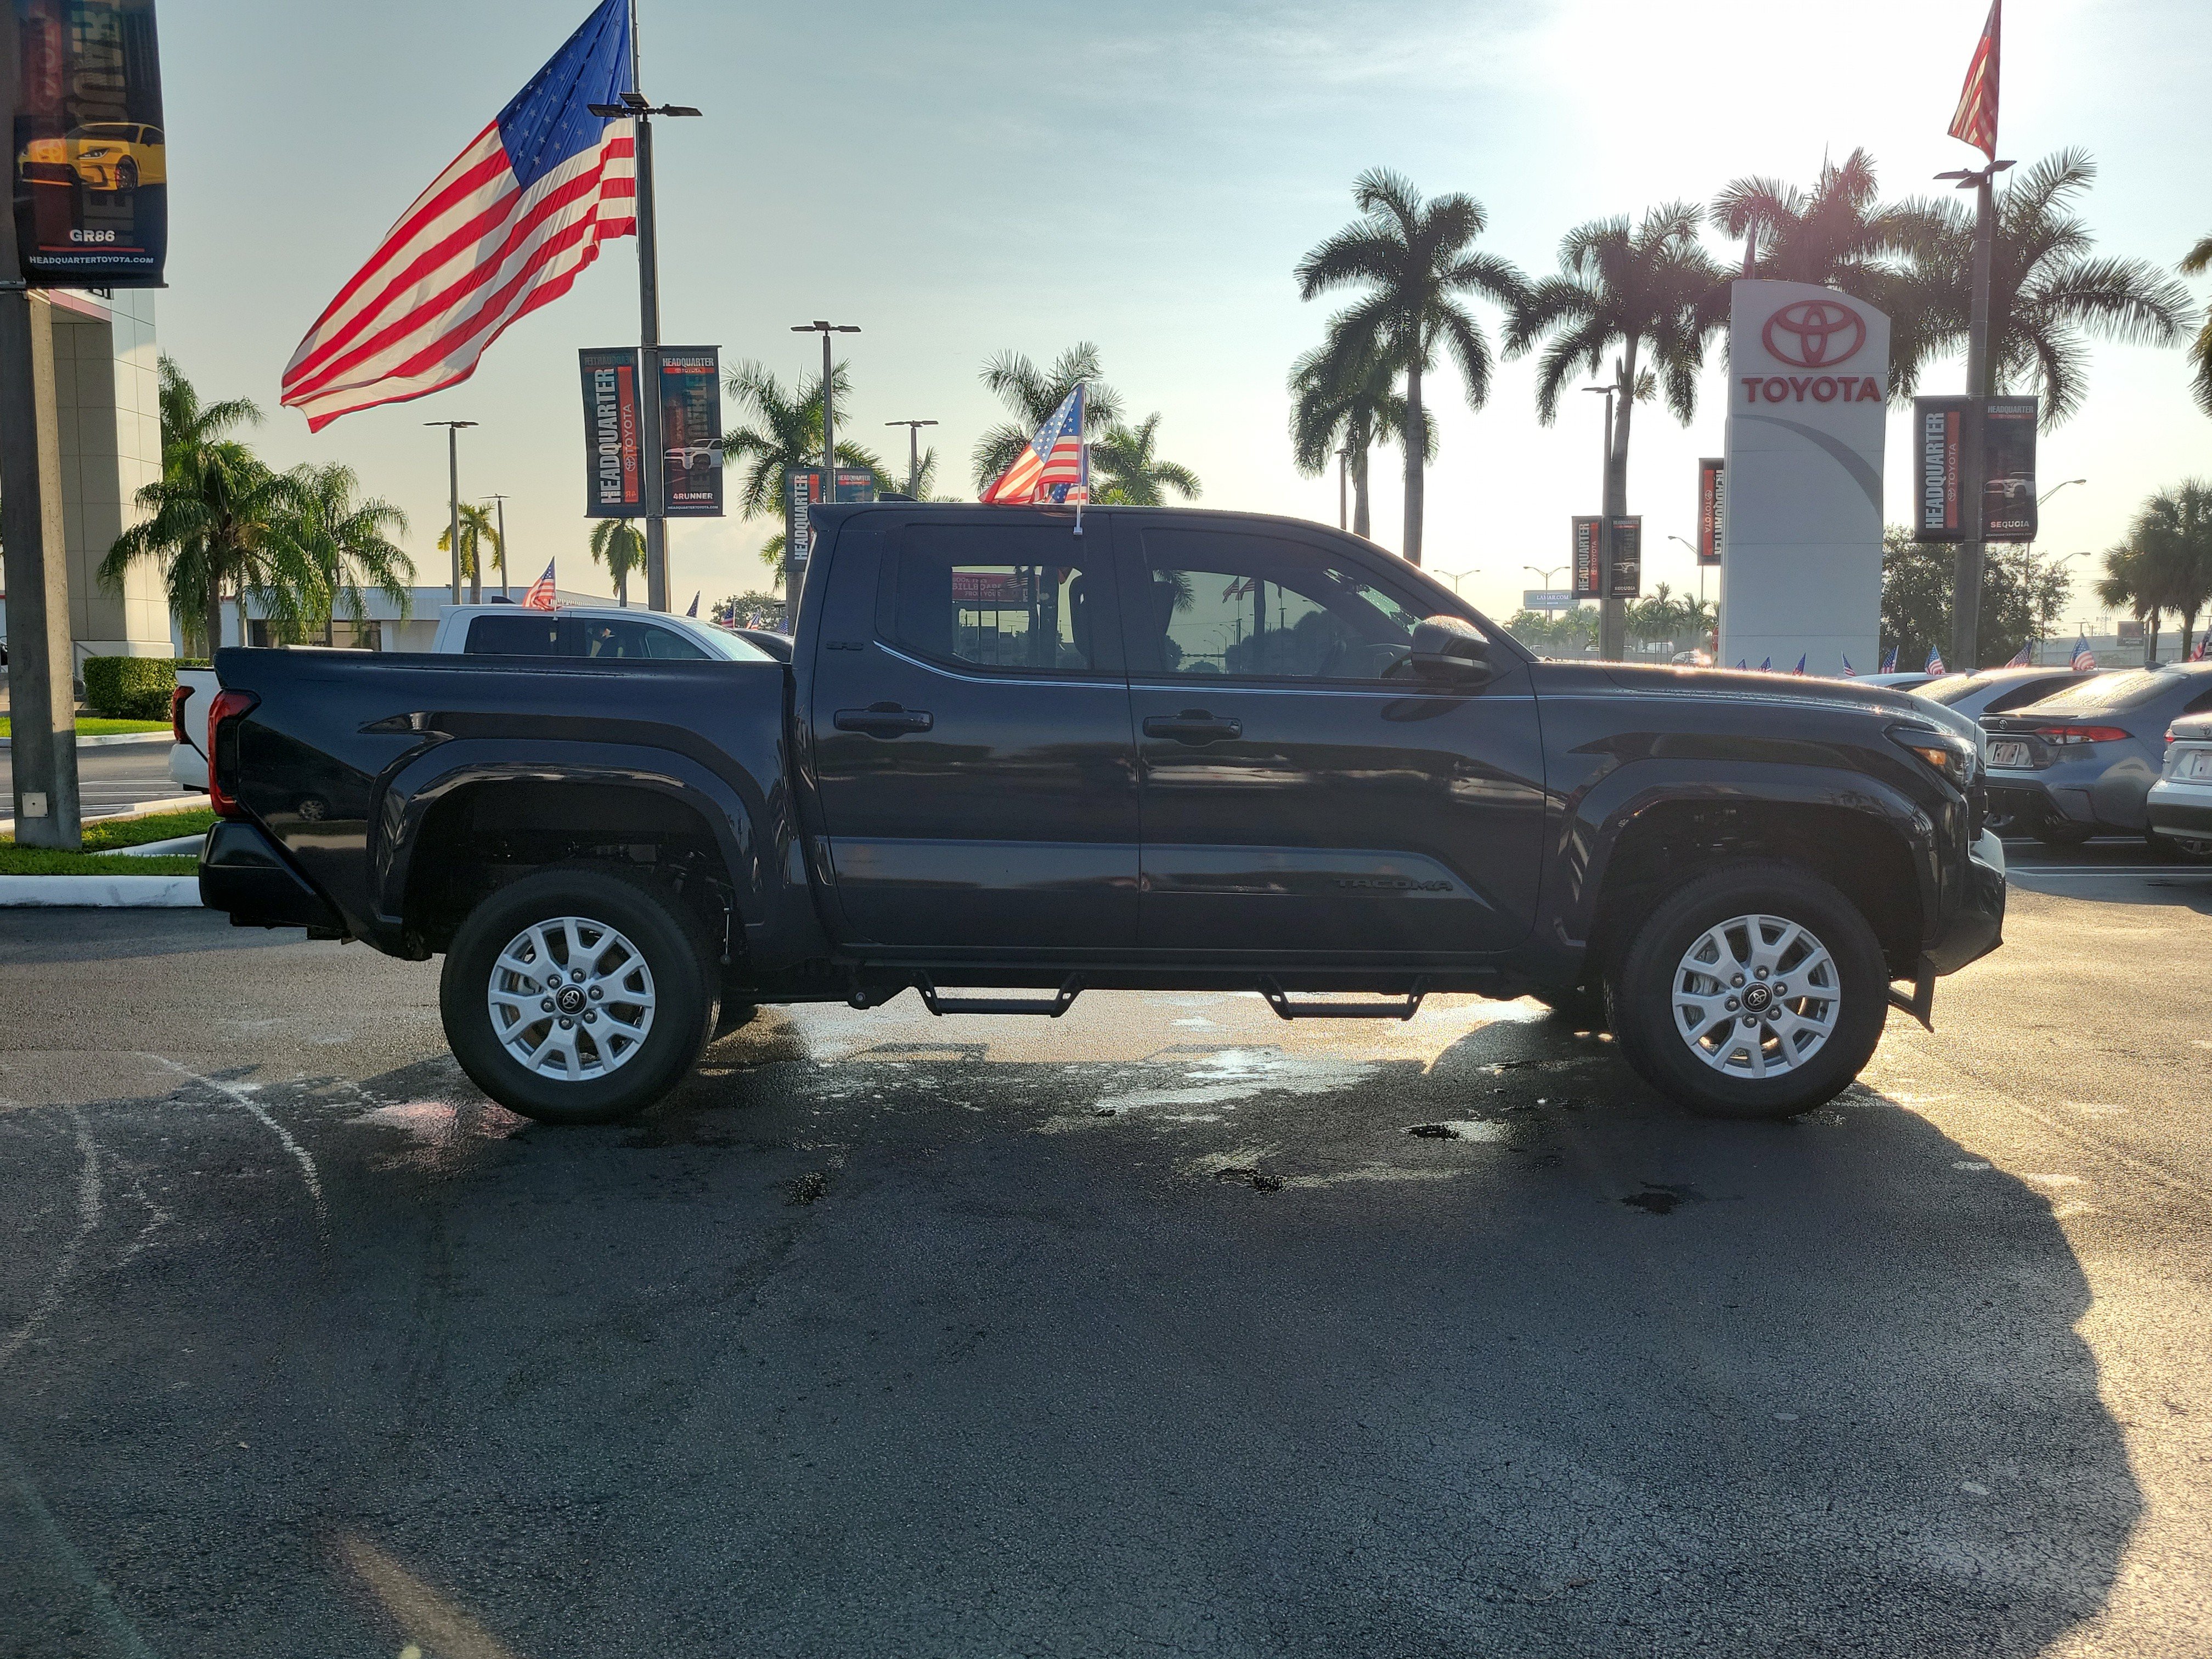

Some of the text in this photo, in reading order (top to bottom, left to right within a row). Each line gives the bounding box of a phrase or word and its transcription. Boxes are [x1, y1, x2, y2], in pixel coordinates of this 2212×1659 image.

[70, 229, 115, 242] GR86
[30, 256, 154, 264] HEADQUARTERTOYOTA.COM
[663, 358, 714, 368] HEADQUARTER
[1741, 376, 1882, 402] TOYOTA
[1988, 405, 2034, 414] HEADQUARTER
[595, 368, 622, 504] HEADQUARTER
[623, 404, 634, 454] TOYOTA
[1926, 413, 1946, 528] HEADQUARTER
[1948, 443, 1956, 487] TOYOTA
[794, 475, 810, 560] HEADQUARTER
[1990, 520, 2029, 528] SEQUOIA
[1578, 523, 1590, 591] HEADQUARTER
[1334, 879, 1454, 891] TACOMA
